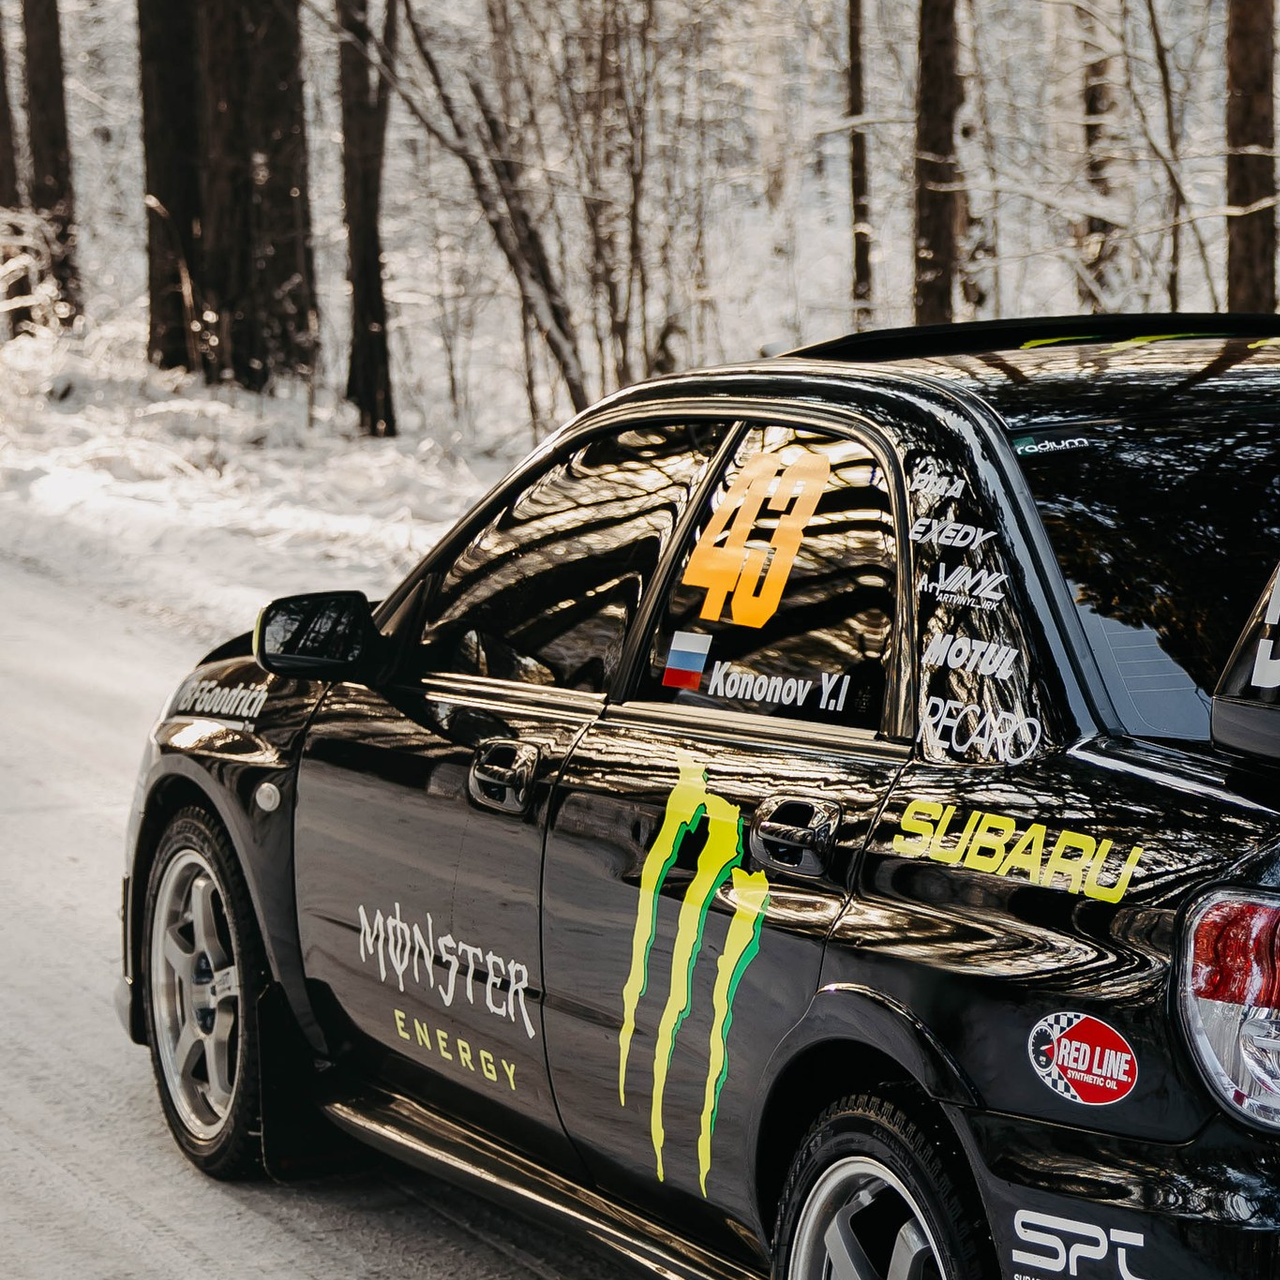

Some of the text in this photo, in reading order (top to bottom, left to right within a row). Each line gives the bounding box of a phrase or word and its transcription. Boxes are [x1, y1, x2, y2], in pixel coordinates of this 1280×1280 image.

[1016, 437, 1089, 455] radium
[909, 472, 966, 499] PIAA
[681, 452, 831, 629] 43
[908, 517, 998, 550] EXEDY
[921, 631, 1020, 681] MOTUL
[708, 660, 813, 707] Kononov
[916, 695, 1042, 766] RECARO
[893, 799, 1143, 905] SUBARU
[394, 1008, 516, 1091] ENERGY
[1057, 1037, 1091, 1071] RED
[1066, 1069, 1118, 1090] SYNTHETIC OIL
